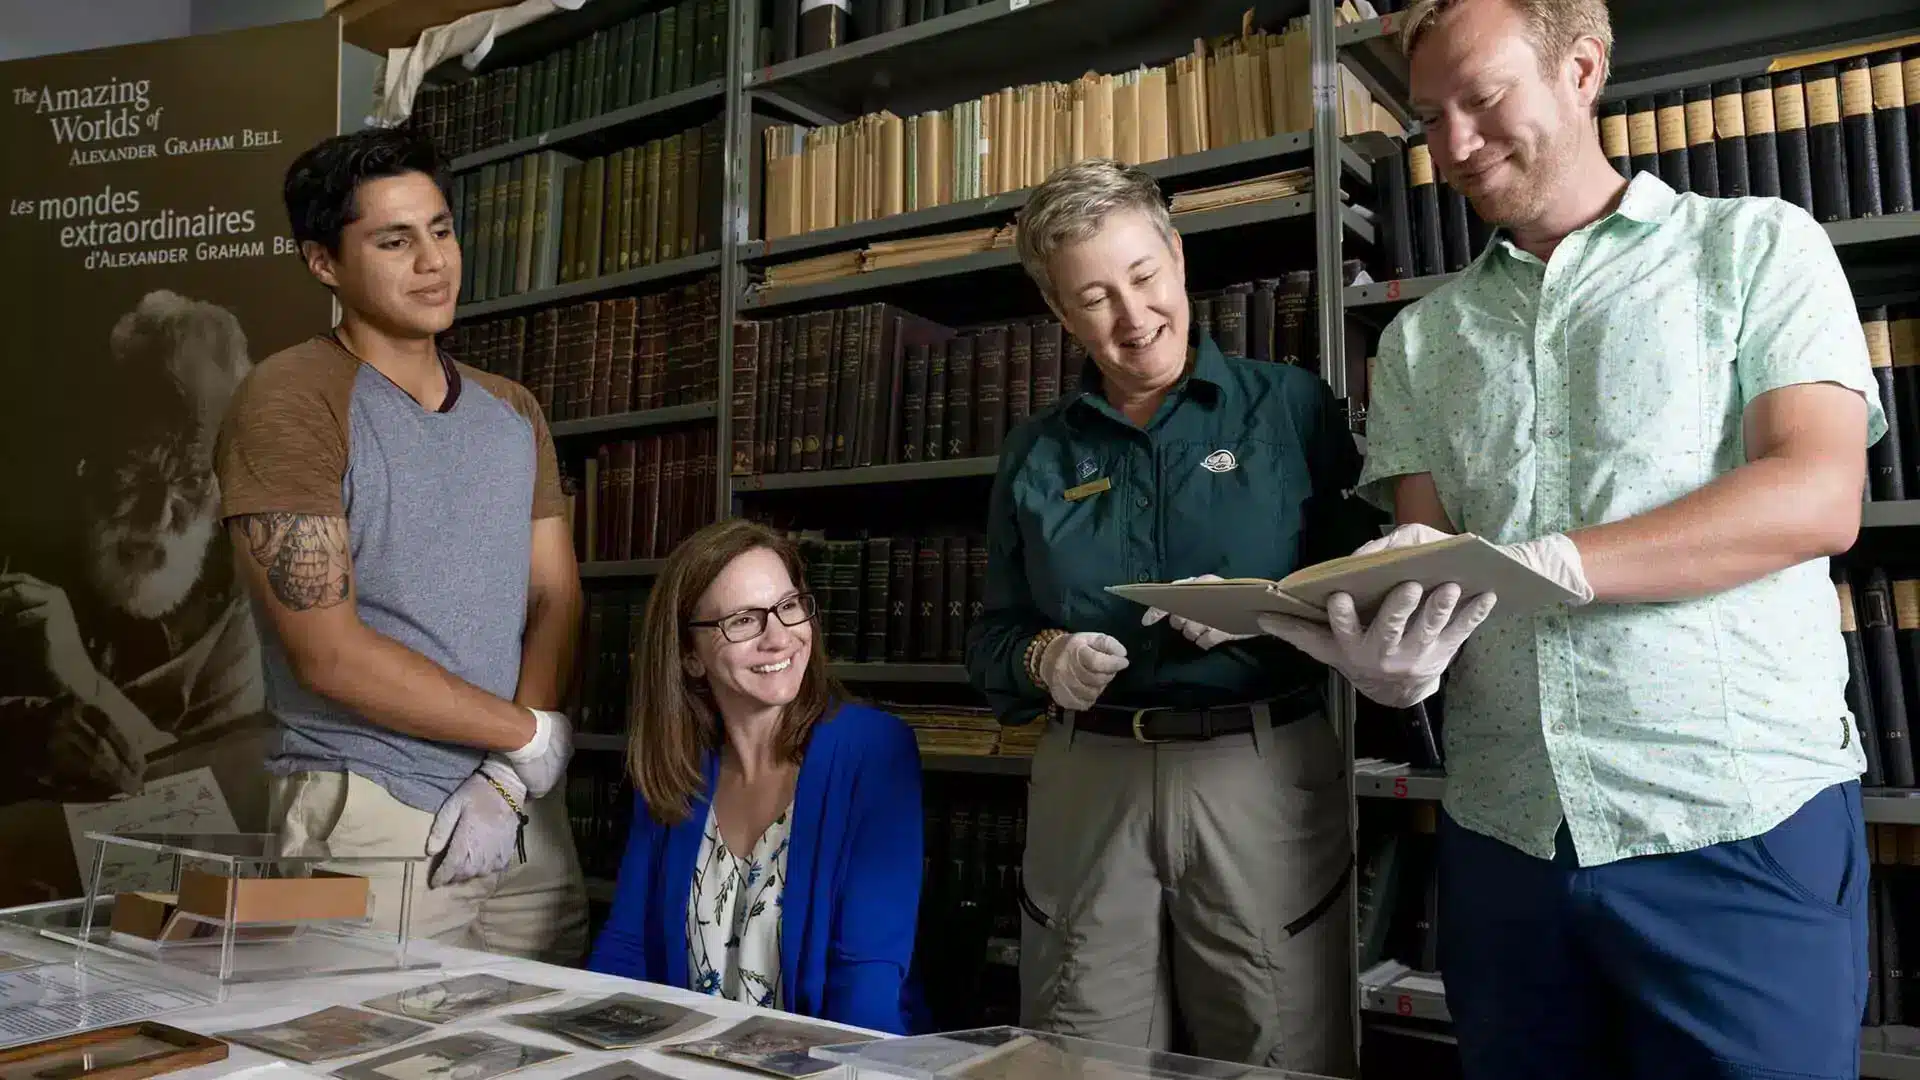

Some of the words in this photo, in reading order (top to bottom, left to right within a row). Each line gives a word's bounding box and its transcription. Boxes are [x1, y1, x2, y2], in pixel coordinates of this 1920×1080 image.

[12, 87, 38, 105] The
[36, 76, 151, 114] Amazing
[50, 109, 140, 145] Worlds
[146, 107, 164, 131] of
[68, 143, 157, 167] ALEXANDER
[164, 134, 235, 157] GRAHAM
[242, 129, 283, 148] BELL
[10, 199, 34, 216] Les
[39, 185, 140, 220] mondes
[60, 206, 256, 248] extraordinaires
[196, 241, 265, 261] GRAHAM
[1387, 280, 1400, 299] 3
[1393, 777, 1408, 798] 5
[1398, 995, 1412, 1015] 6
